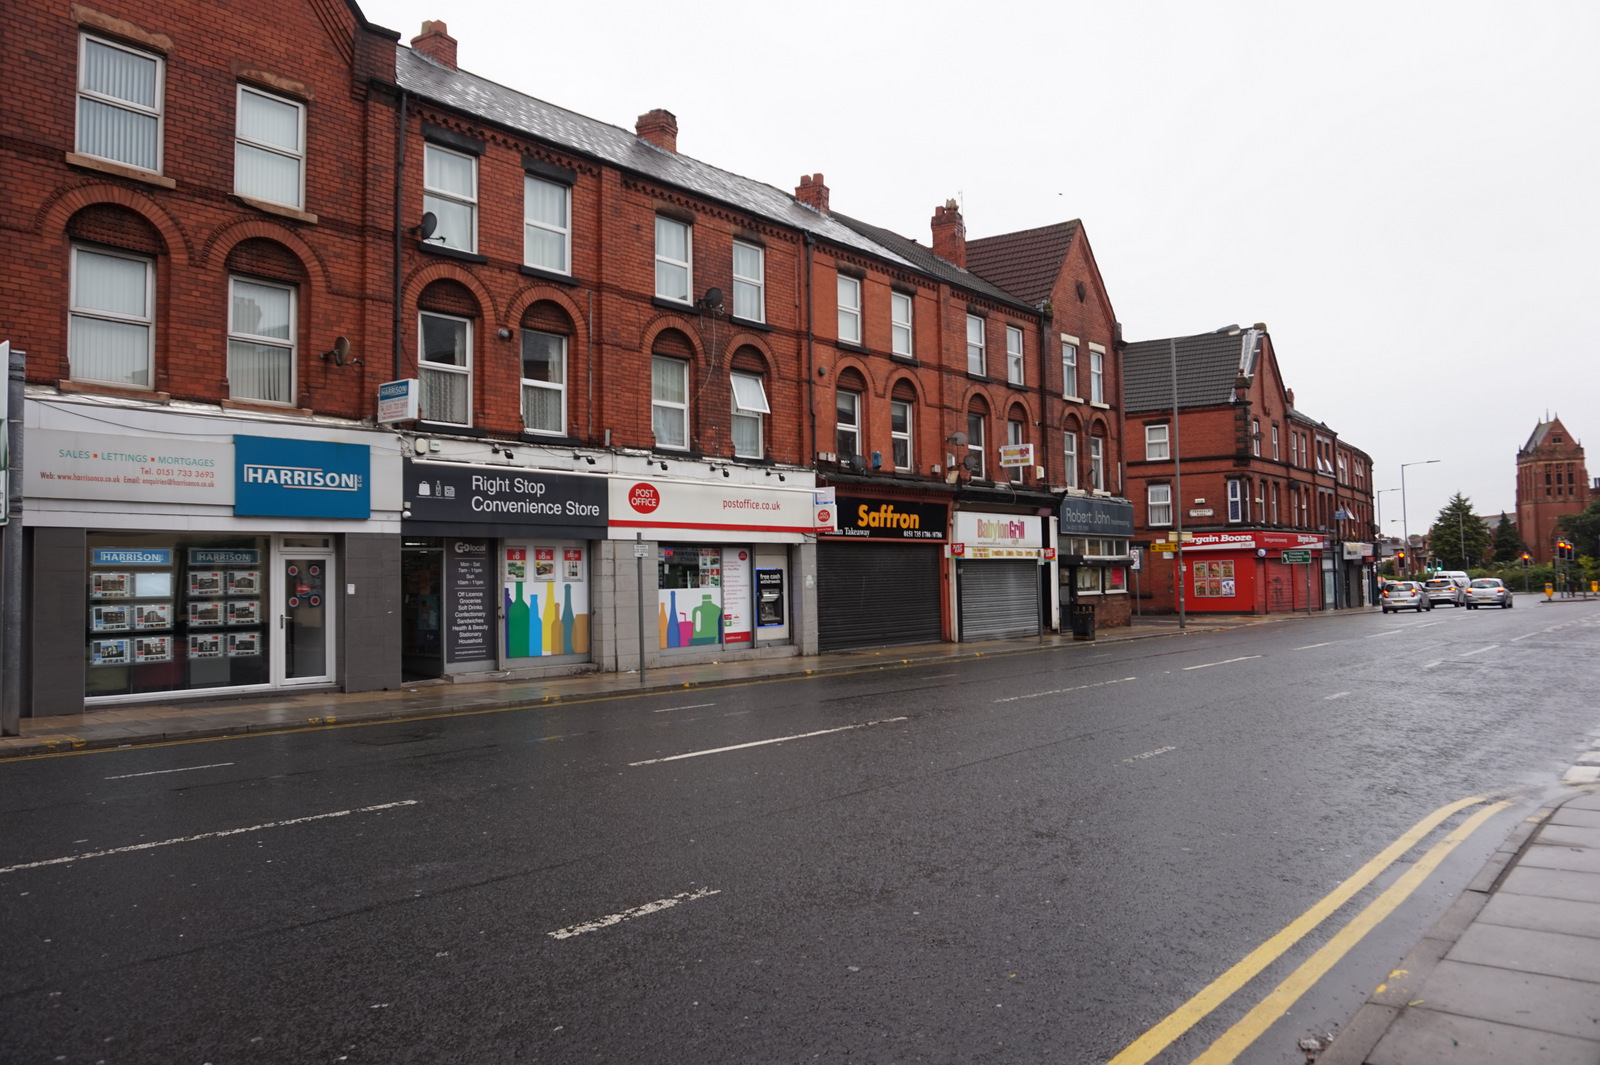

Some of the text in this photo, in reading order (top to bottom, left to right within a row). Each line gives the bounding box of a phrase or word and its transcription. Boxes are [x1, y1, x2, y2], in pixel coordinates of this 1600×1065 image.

[59, 450, 214, 466] SALES LETTINGS MORTGAGES
[40, 472, 56, 480] Web:
[57, 473, 120, 483] www.harrisonco.co.uk
[123, 476, 140, 484] Email:
[141, 468, 214, 478] Tel. 0151 733 3693
[248, 468, 354, 488] HARRISON
[472, 476, 546, 497] Right Stop
[472, 496, 600, 516] Convenience Store
[632, 489, 657, 507] POST OFFICE
[722, 499, 781, 511] postoffice.co.uk
[857, 504, 920, 529] Saffron
[1066, 508, 1092, 524] Robert
[1094, 511, 1110, 525] John
[844, 527, 870, 538] Takeaway
[978, 519, 1025, 541] Babylon Grill
[103, 552, 159, 561] HARRISON
[200, 552, 249, 560] HARRISON
